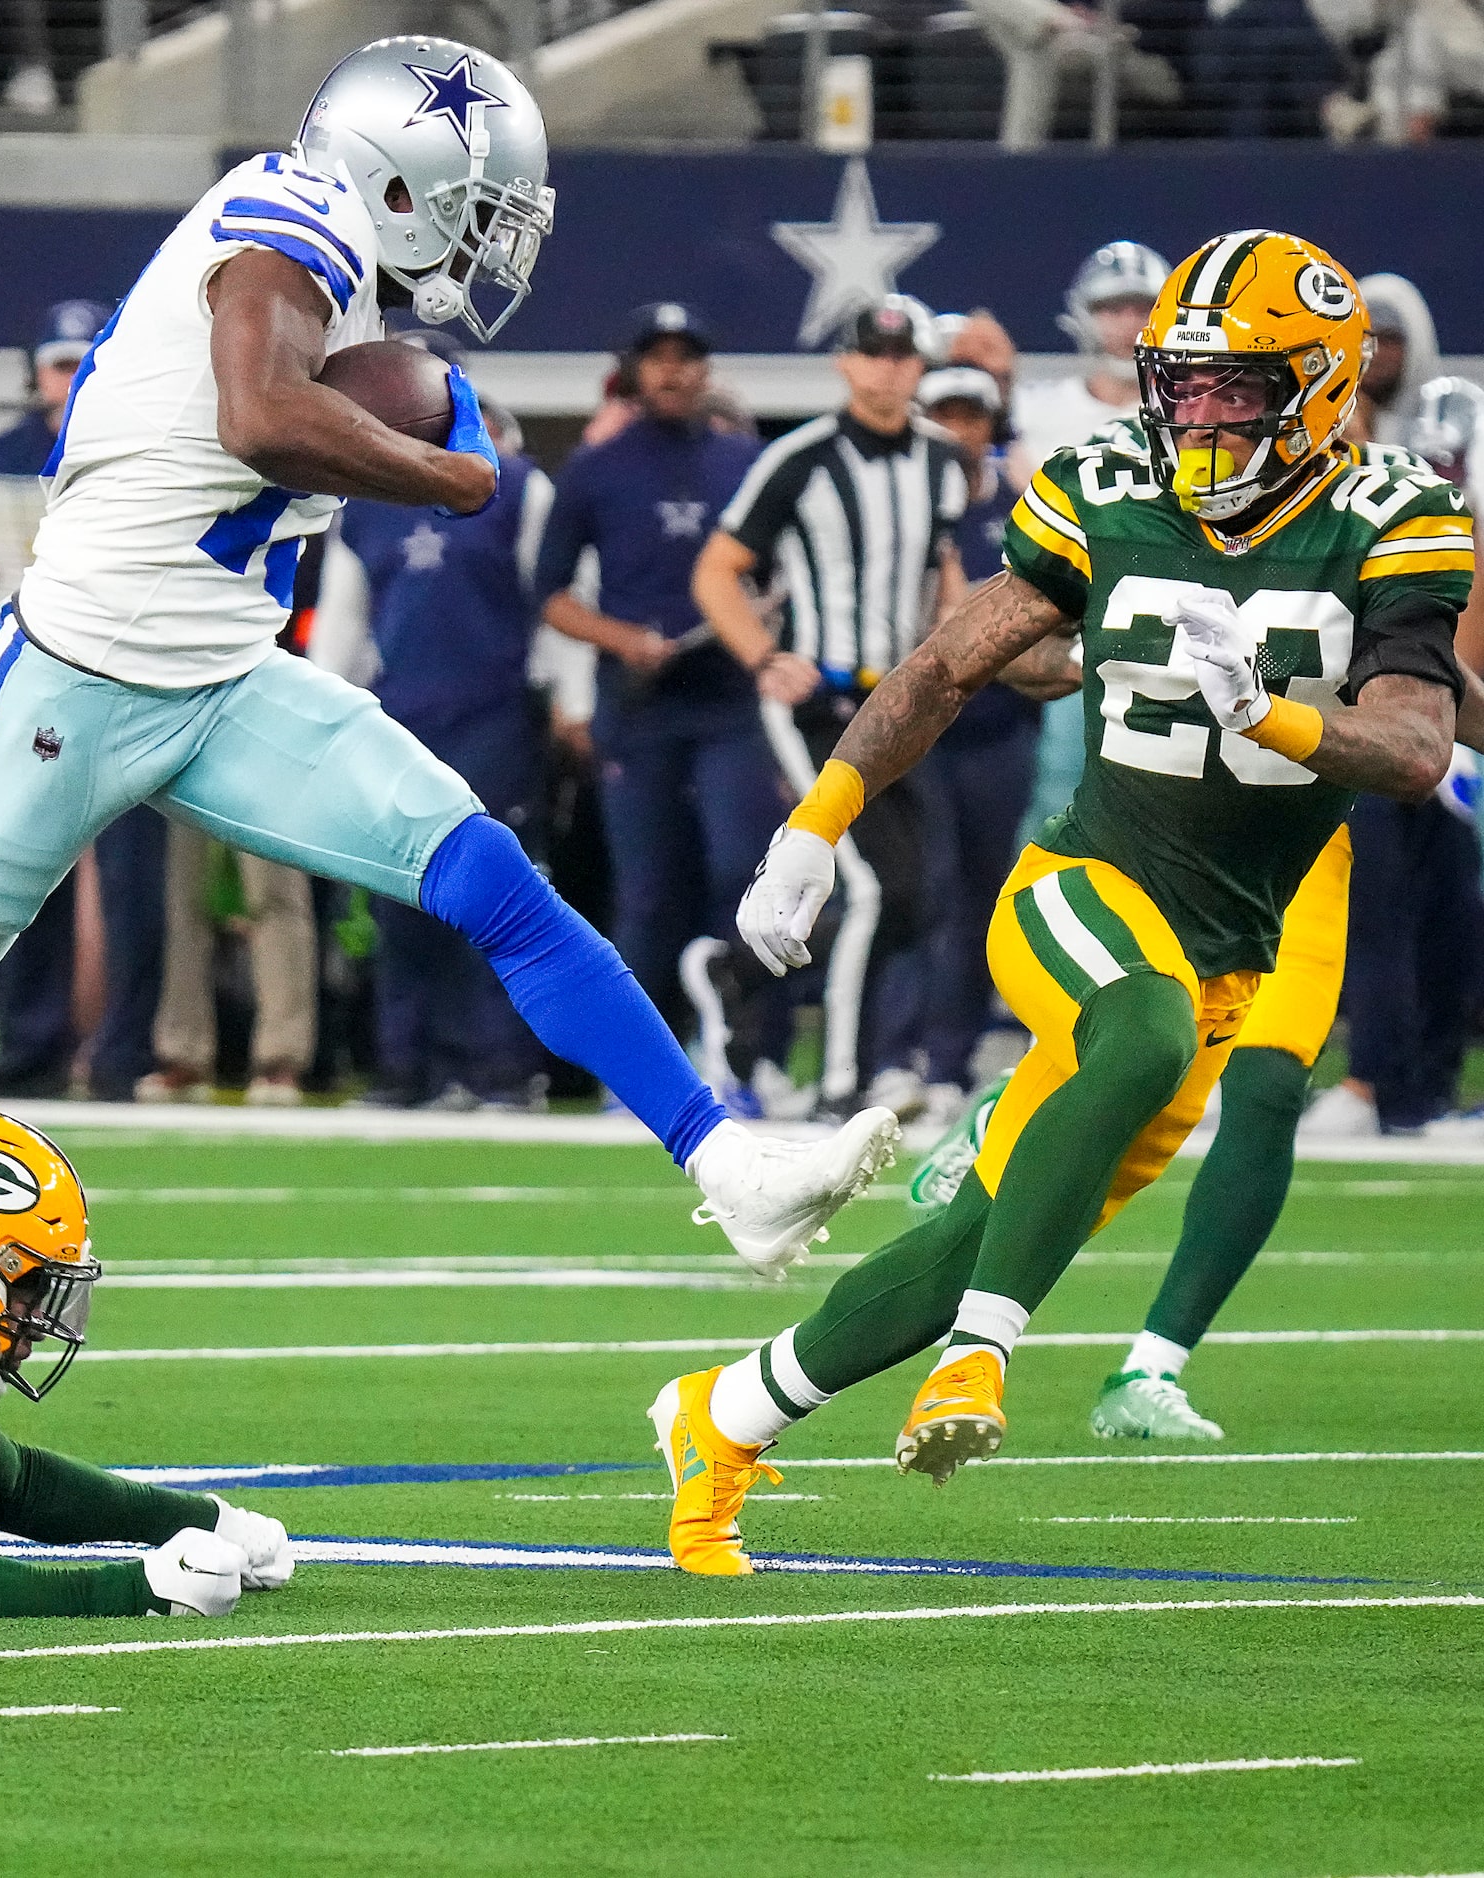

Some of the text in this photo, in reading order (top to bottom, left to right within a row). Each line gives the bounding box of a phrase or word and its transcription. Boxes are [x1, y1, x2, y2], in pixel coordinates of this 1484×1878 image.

[1295, 262, 1354, 321] G
[1176, 330, 1211, 342] PACKERS
[1096, 574, 1354, 786] 23
